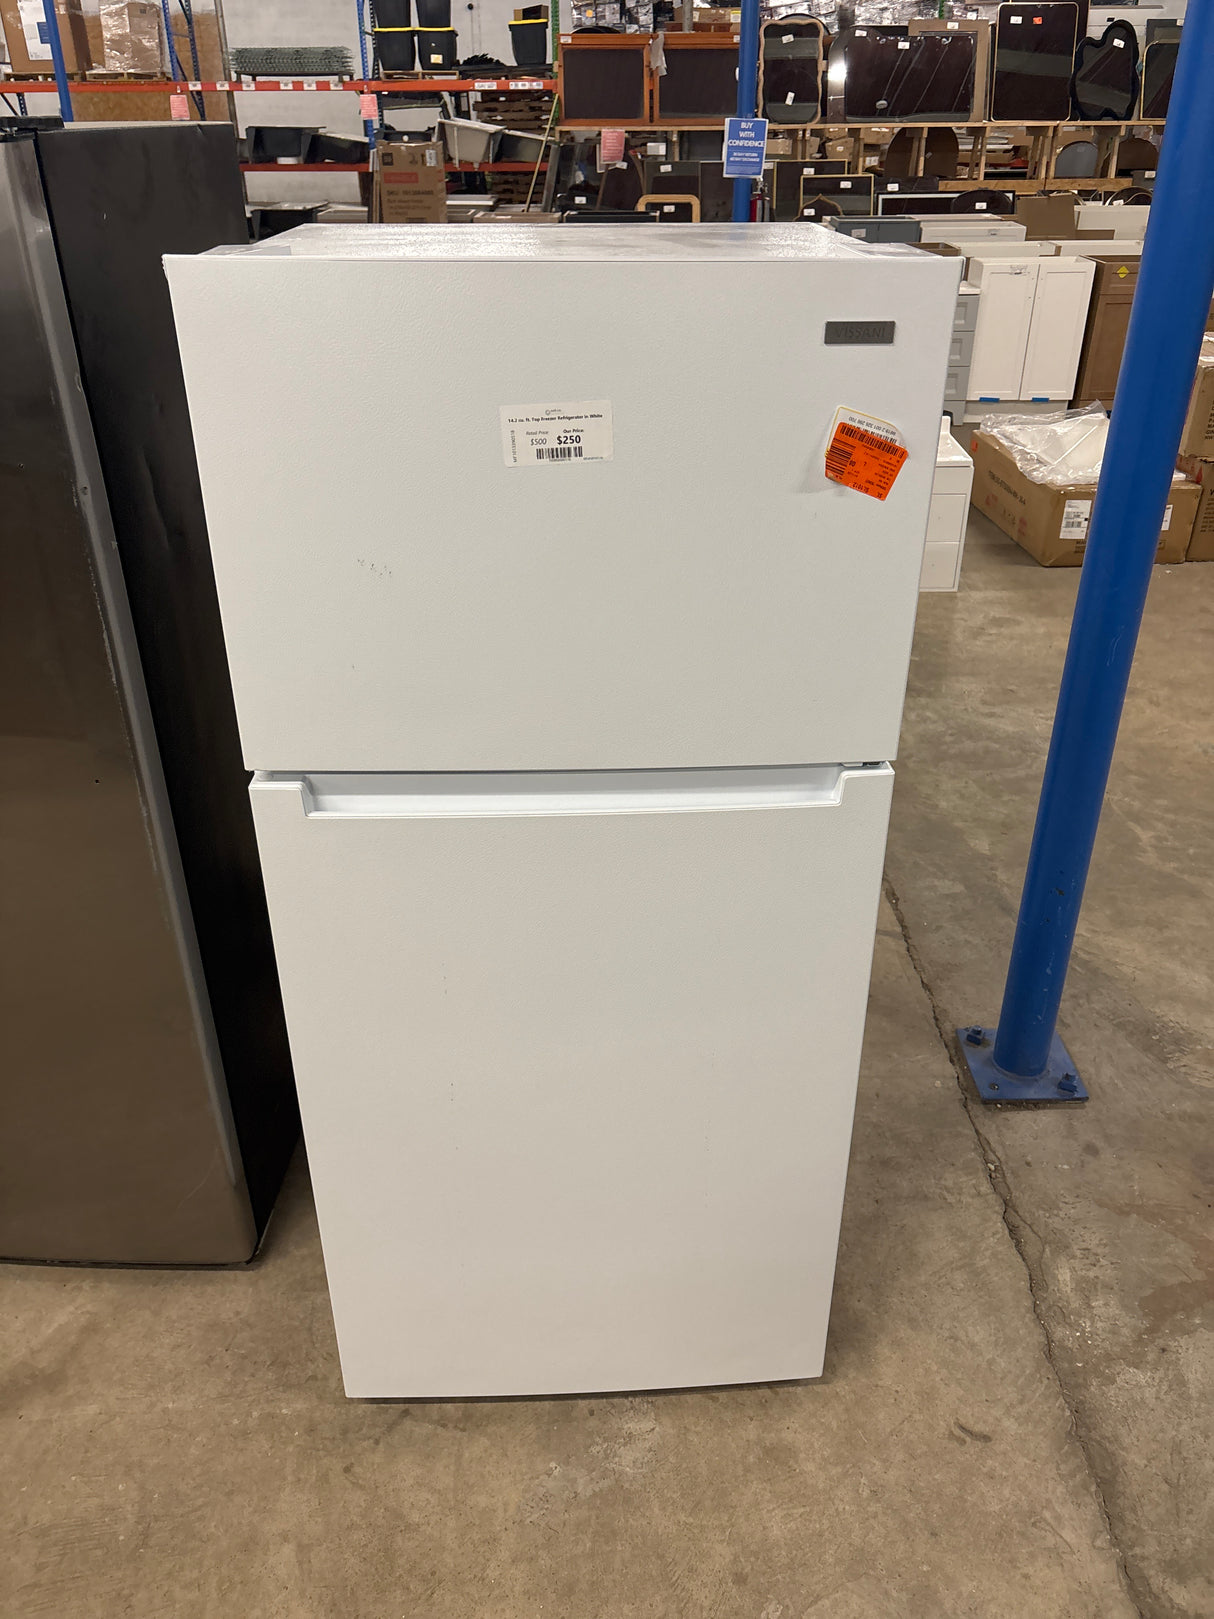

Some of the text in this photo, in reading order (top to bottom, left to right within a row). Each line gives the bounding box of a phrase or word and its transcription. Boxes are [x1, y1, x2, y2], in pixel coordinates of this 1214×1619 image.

[836, 327, 885, 338] VISSANI
[530, 438, 547, 446] $500
[556, 435, 581, 445] $250
